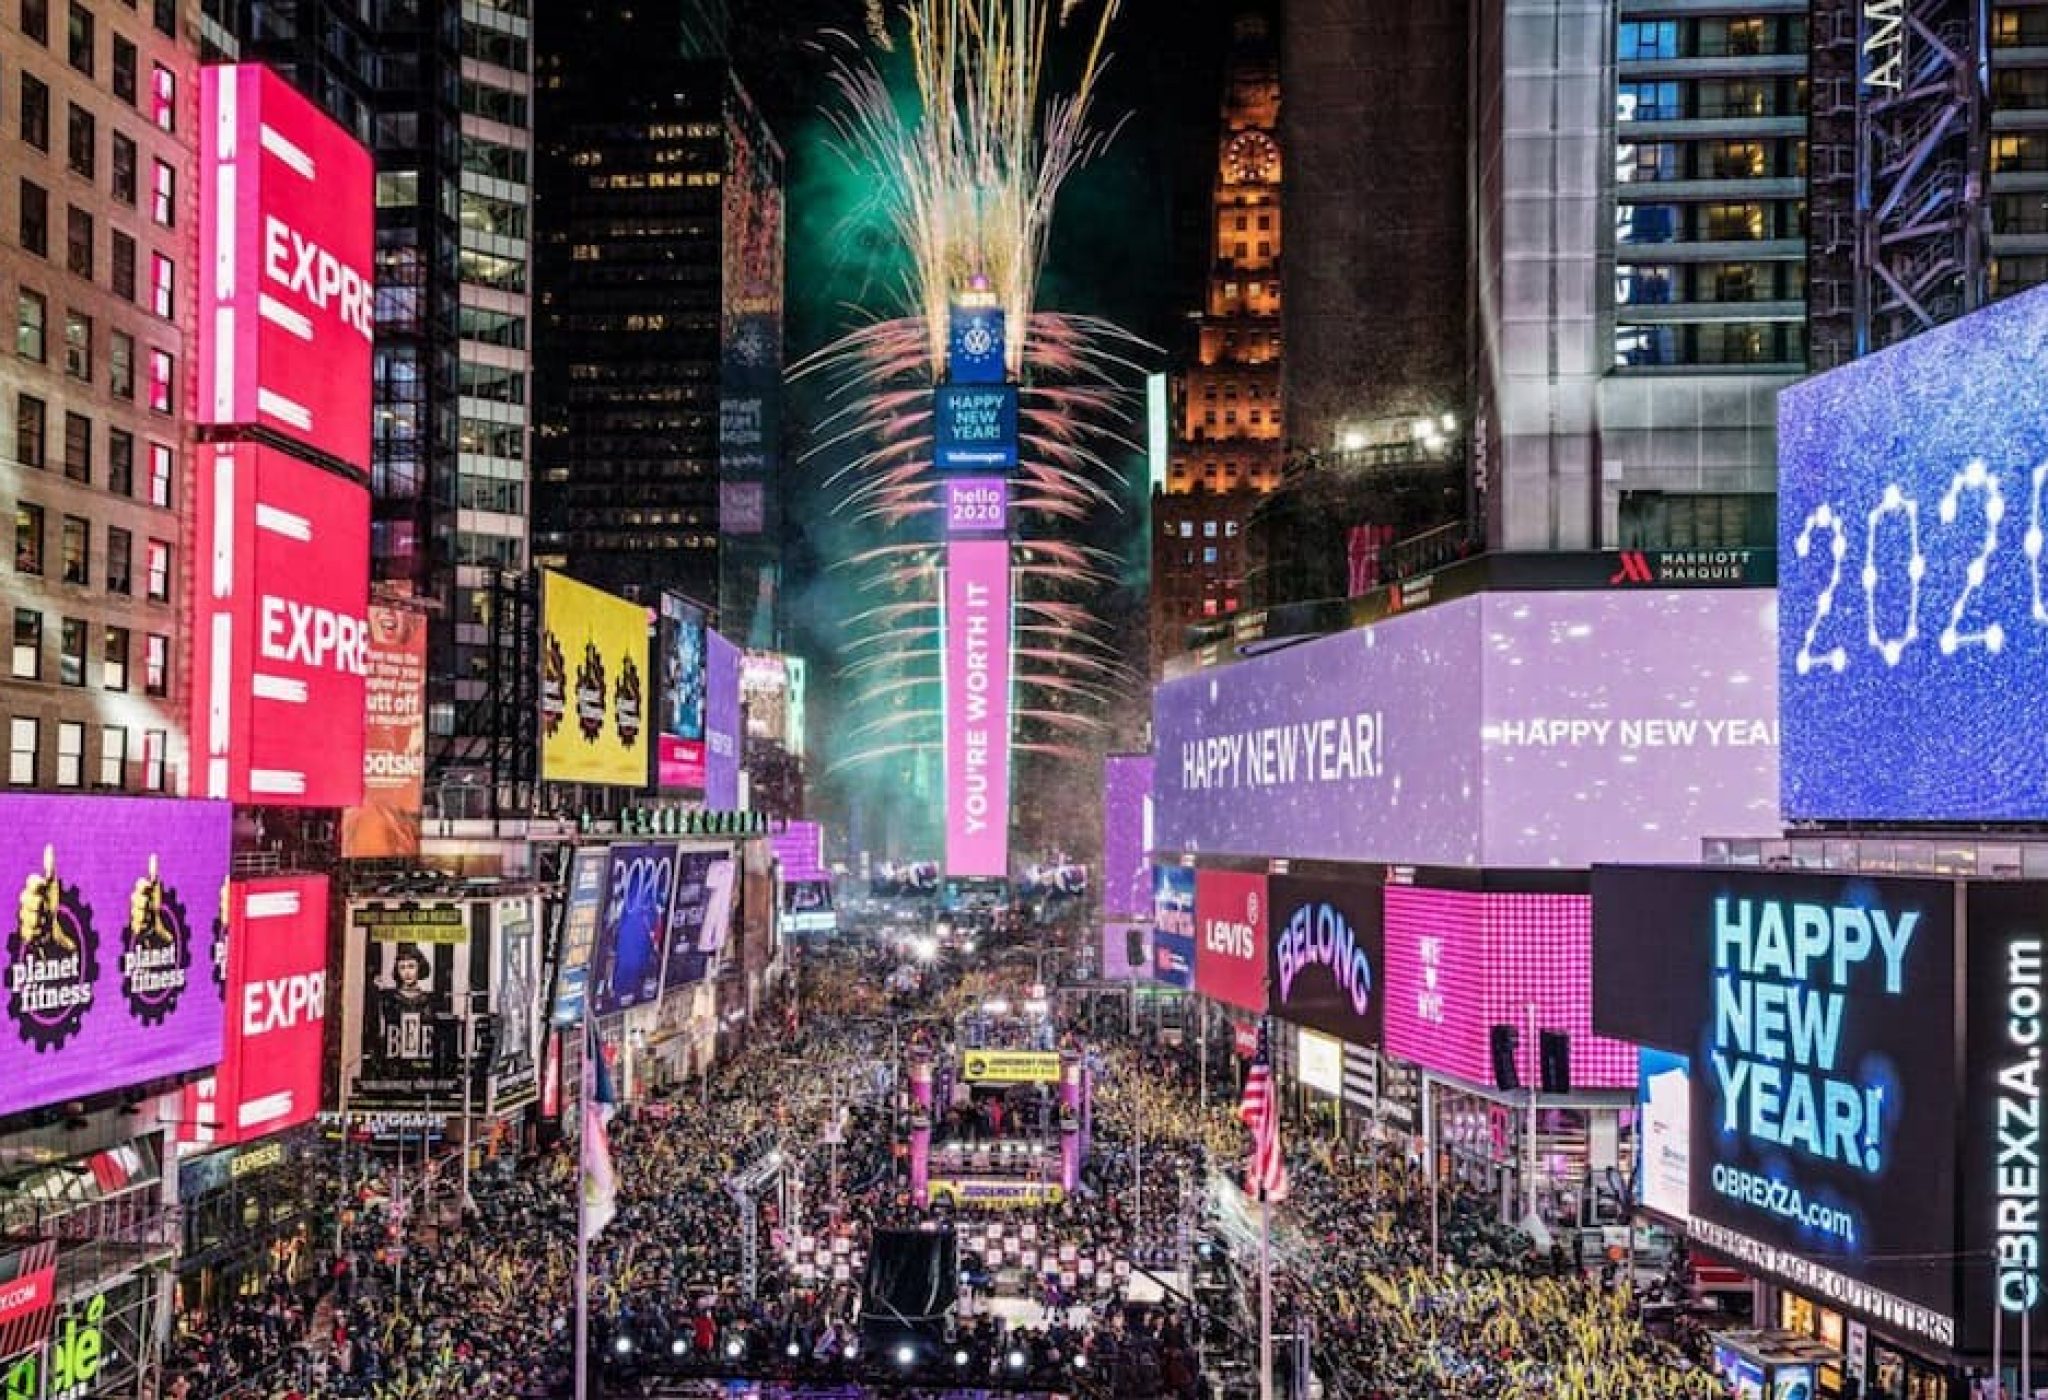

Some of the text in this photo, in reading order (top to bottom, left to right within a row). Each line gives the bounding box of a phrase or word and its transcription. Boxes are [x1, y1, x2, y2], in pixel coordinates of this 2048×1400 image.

[266, 213, 373, 342] EXPRE
[949, 396, 1005, 410] HAPPY
[955, 411, 997, 424] NEW
[952, 425, 1000, 440] YEAR!
[952, 488, 1000, 503] hello
[952, 505, 1001, 520] 2020
[1660, 551, 1750, 564] MARRIOTT
[1660, 566, 1741, 579] MARQUIS
[261, 594, 367, 676] EXPRE
[365, 694, 392, 712] utt
[965, 581, 989, 836] YOU'RE WORTH IT
[1502, 719, 1614, 746] HAPPY
[1620, 719, 1698, 746] NEW
[1183, 710, 1384, 790] HAPPY NEW YEAR!
[124, 943, 176, 975] planet
[1276, 903, 1373, 1016] BELONG
[1714, 897, 1920, 994] HAPPY
[12, 952, 79, 991] planet
[130, 968, 185, 994] fitness
[21, 982, 92, 1013] fitness
[1714, 972, 1846, 1071] NEW
[1710, 1048, 1885, 1174] YEAR!
[1998, 940, 2041, 1312] QBREXZA.com
